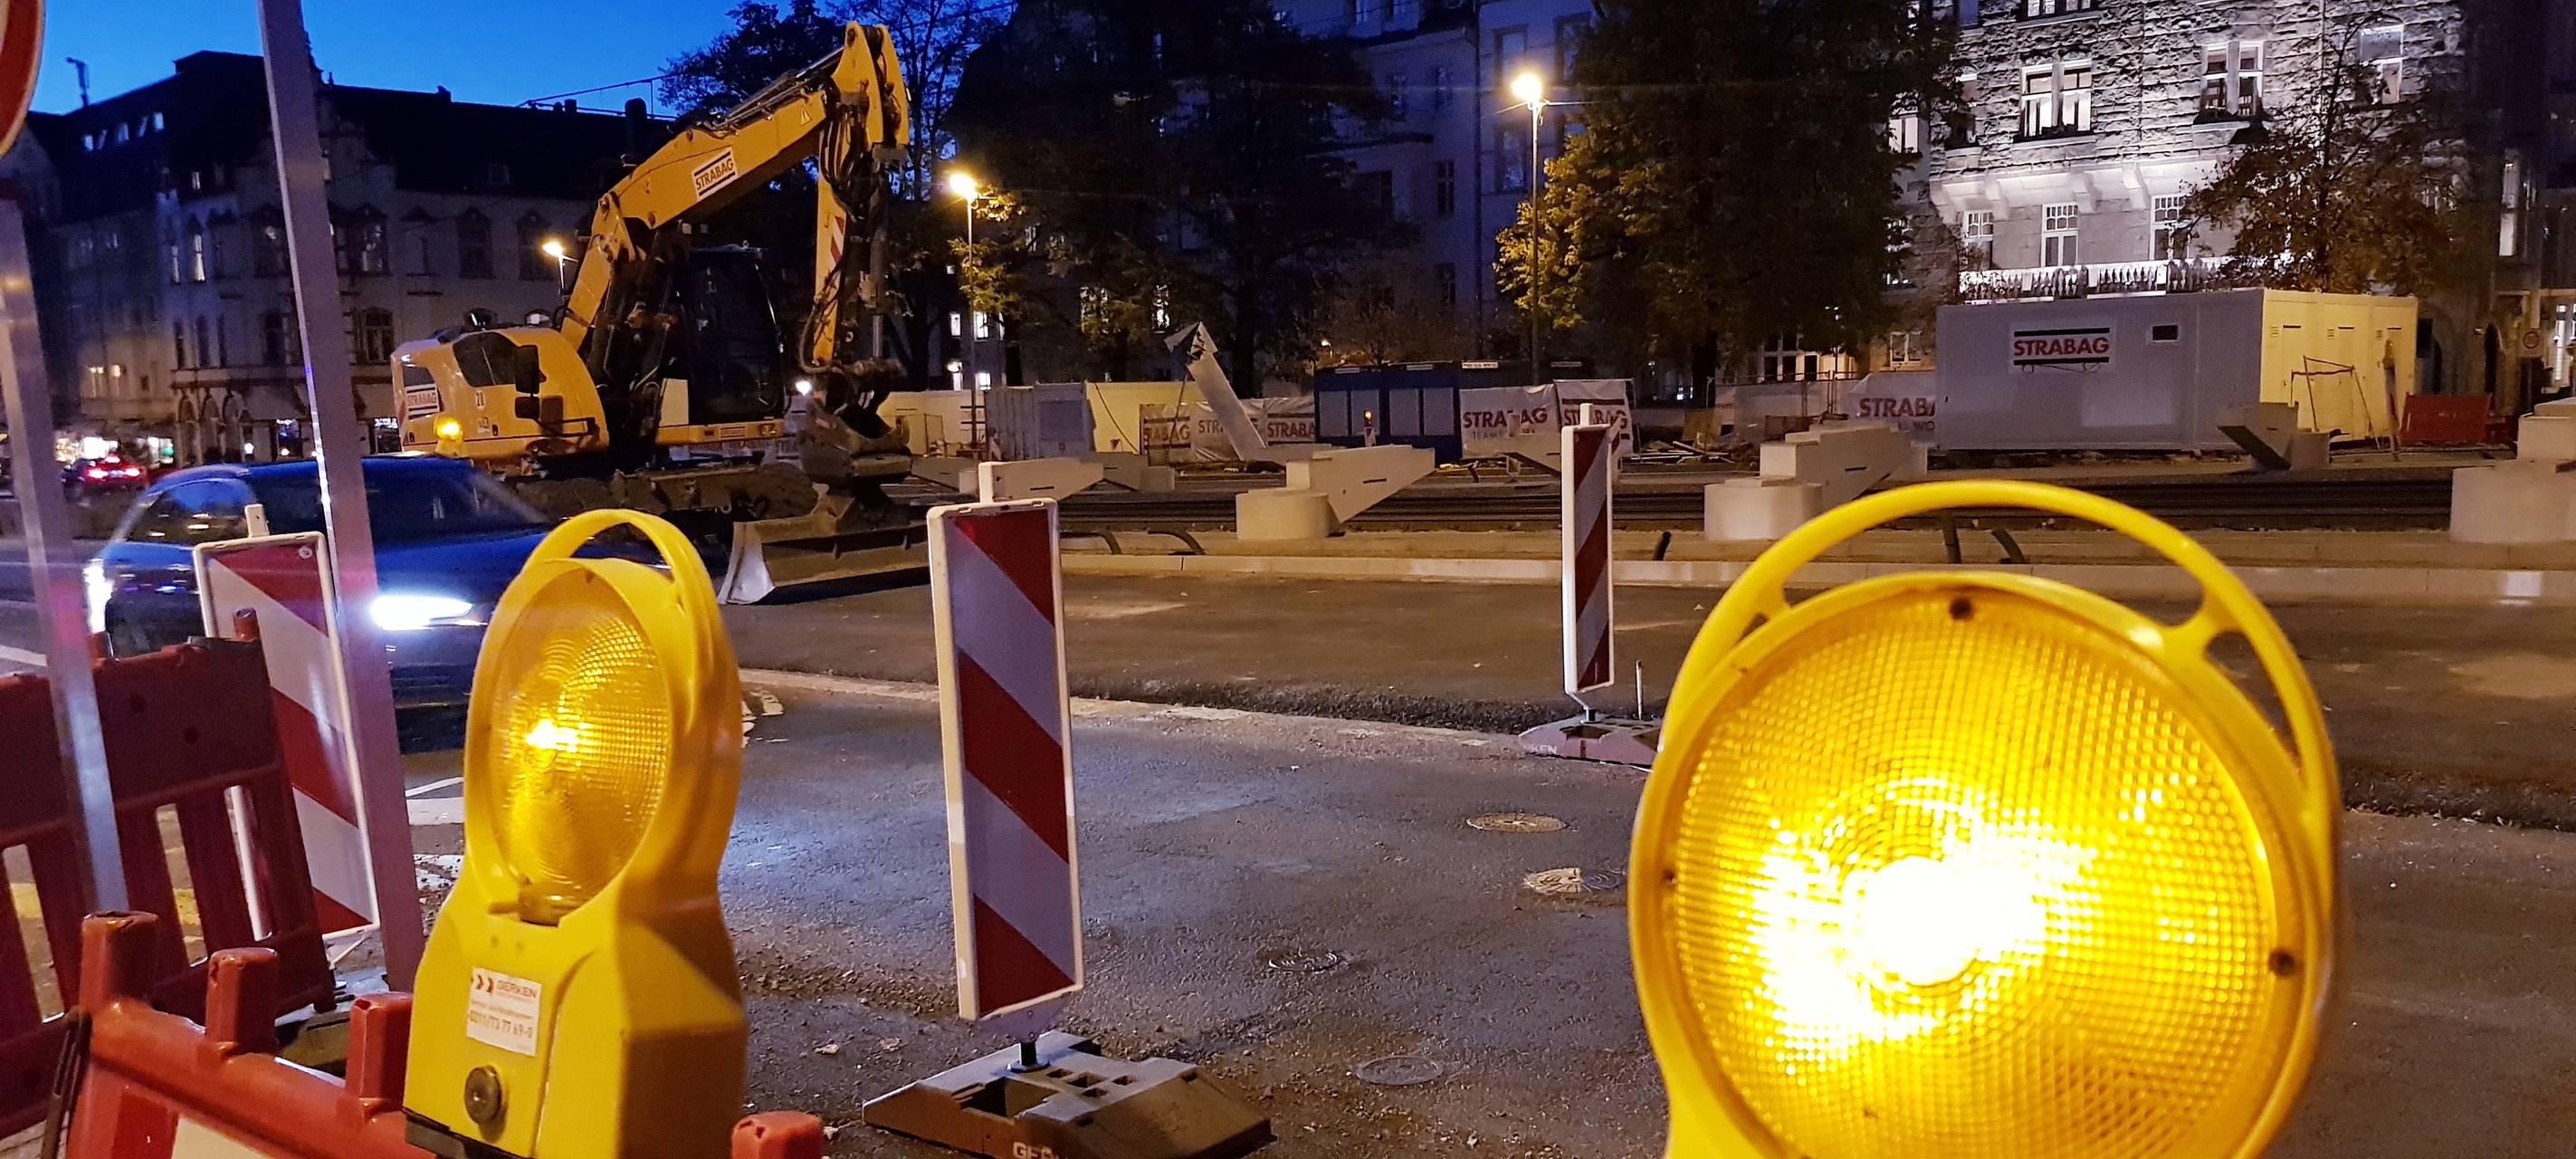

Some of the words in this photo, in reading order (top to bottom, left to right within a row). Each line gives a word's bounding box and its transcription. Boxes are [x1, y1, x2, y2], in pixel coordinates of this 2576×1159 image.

[695, 158, 733, 190] STRABAG
[2014, 337, 2110, 356] STRABAG
[1463, 407, 1548, 428] STRAAG
